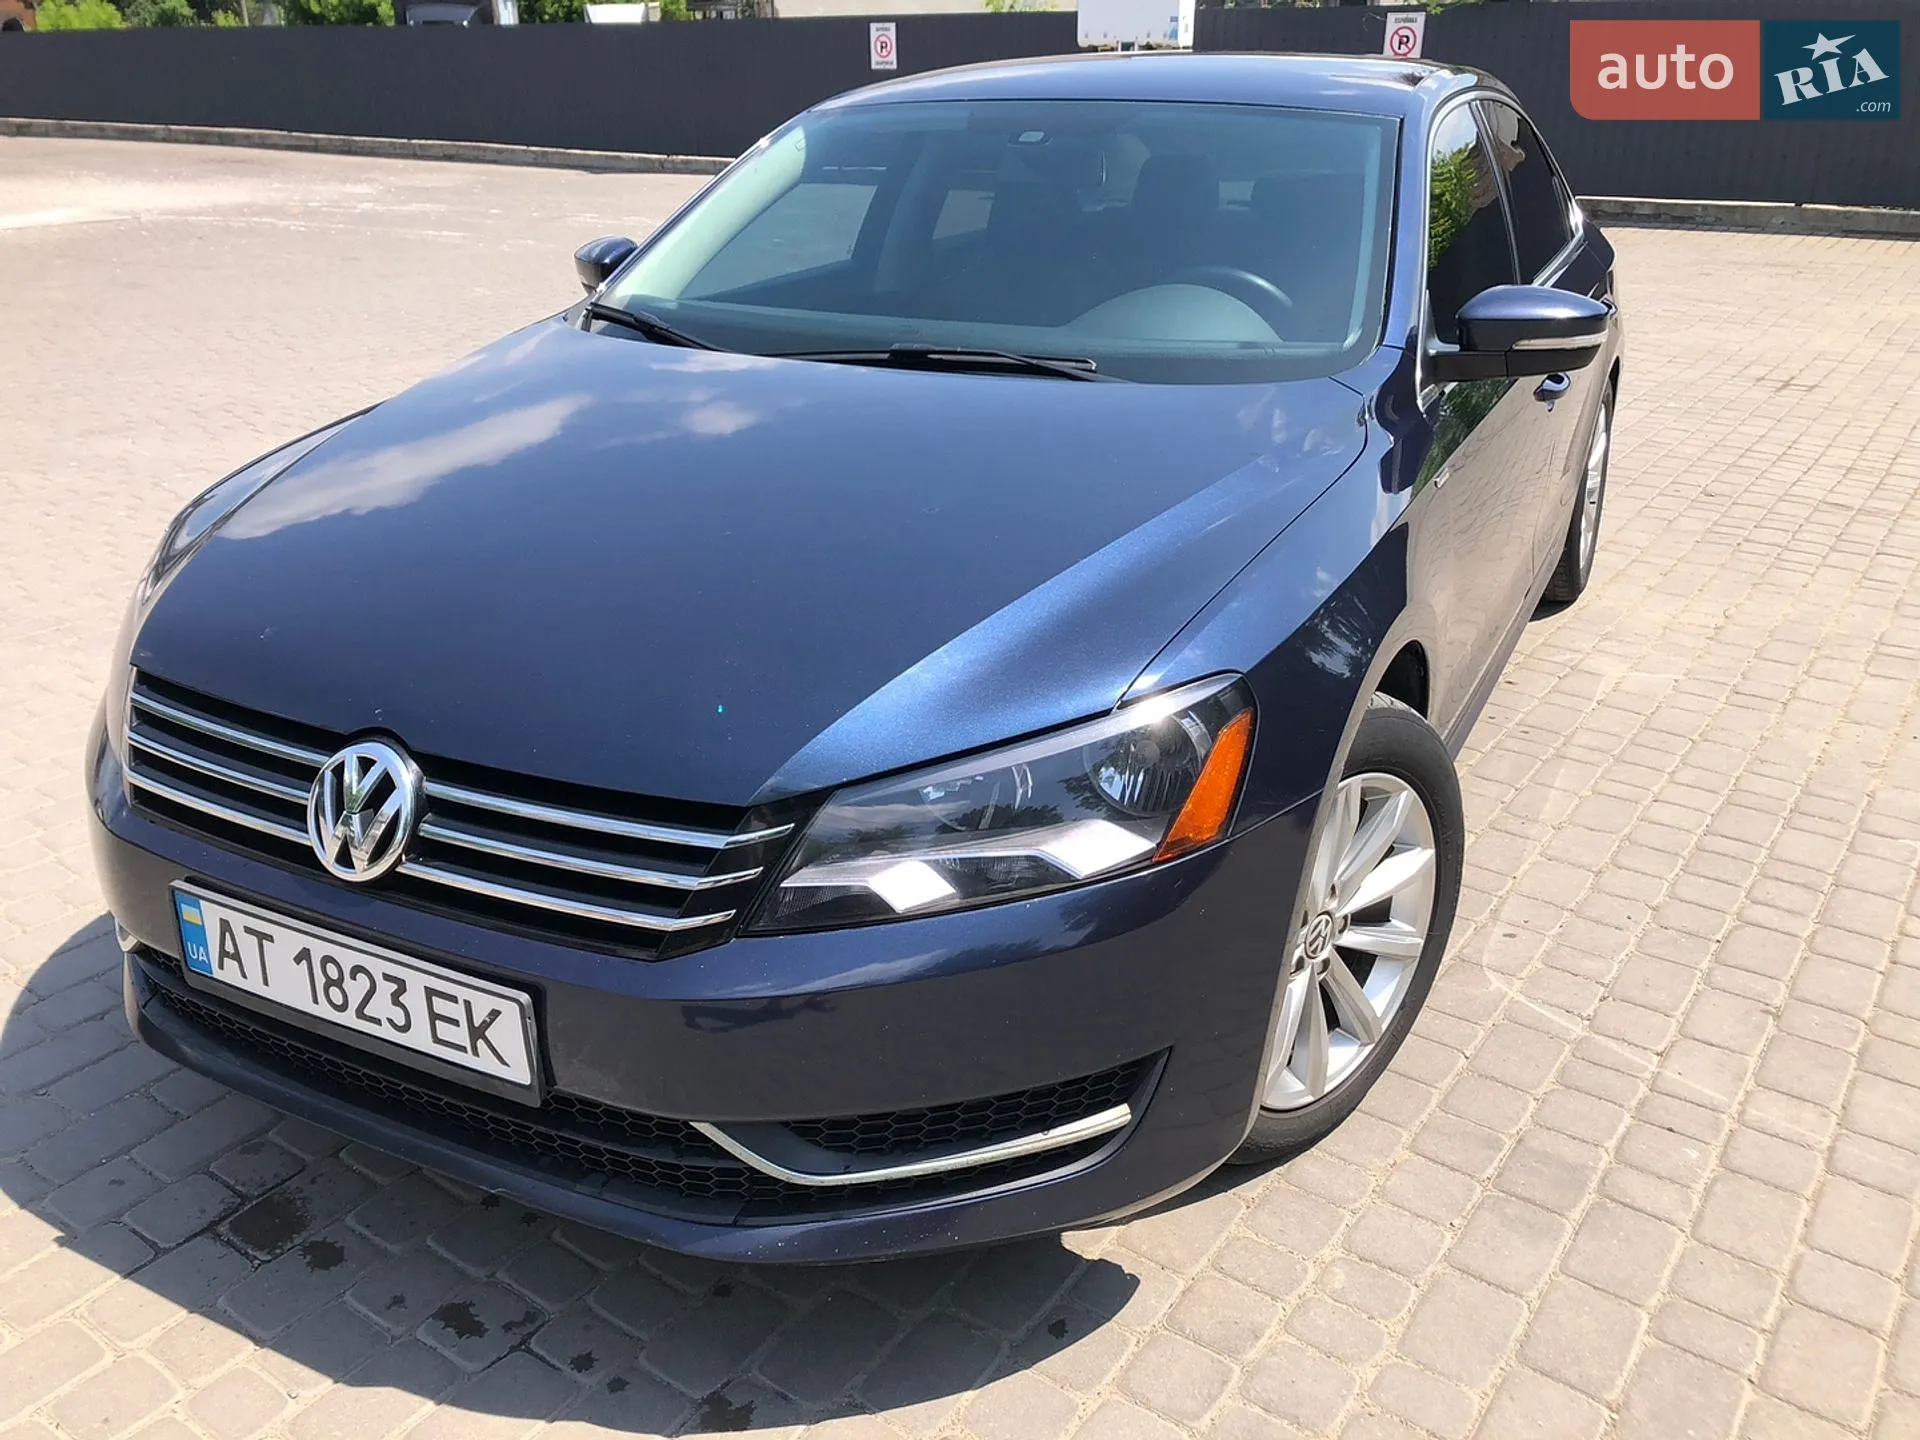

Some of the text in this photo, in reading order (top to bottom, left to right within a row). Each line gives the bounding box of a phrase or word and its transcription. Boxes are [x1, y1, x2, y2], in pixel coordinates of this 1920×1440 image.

[187, 942, 209, 965] UA
[217, 917, 511, 1068] AT 1823 EK
